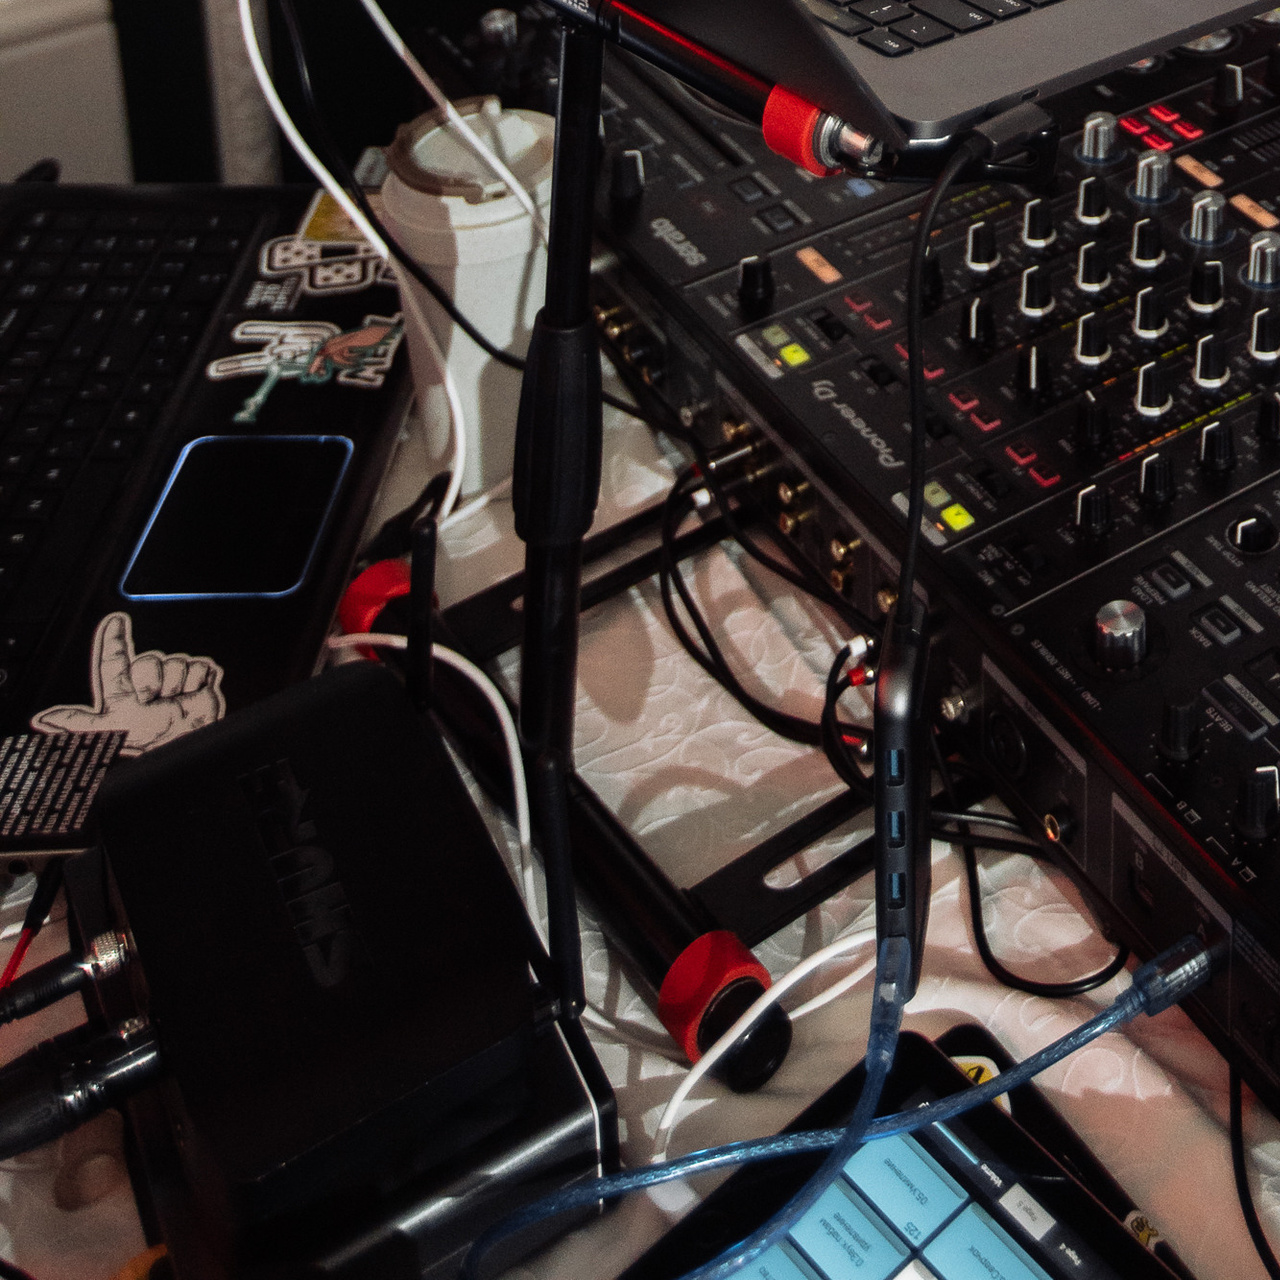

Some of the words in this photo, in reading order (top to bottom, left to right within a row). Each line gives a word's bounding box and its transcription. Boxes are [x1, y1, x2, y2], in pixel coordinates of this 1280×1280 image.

[650, 215, 708, 269] serato
[809, 377, 838, 403] DJ
[833, 400, 905, 470] Pioneer
[1130, 582, 1154, 605] LOAD
[1132, 572, 1168, 605] PREPARE
[1187, 625, 1212, 649] BACK
[1204, 704, 1234, 732] BEATS
[980, 1162, 1003, 1188] Volume
[904, 1221, 922, 1240] 125
